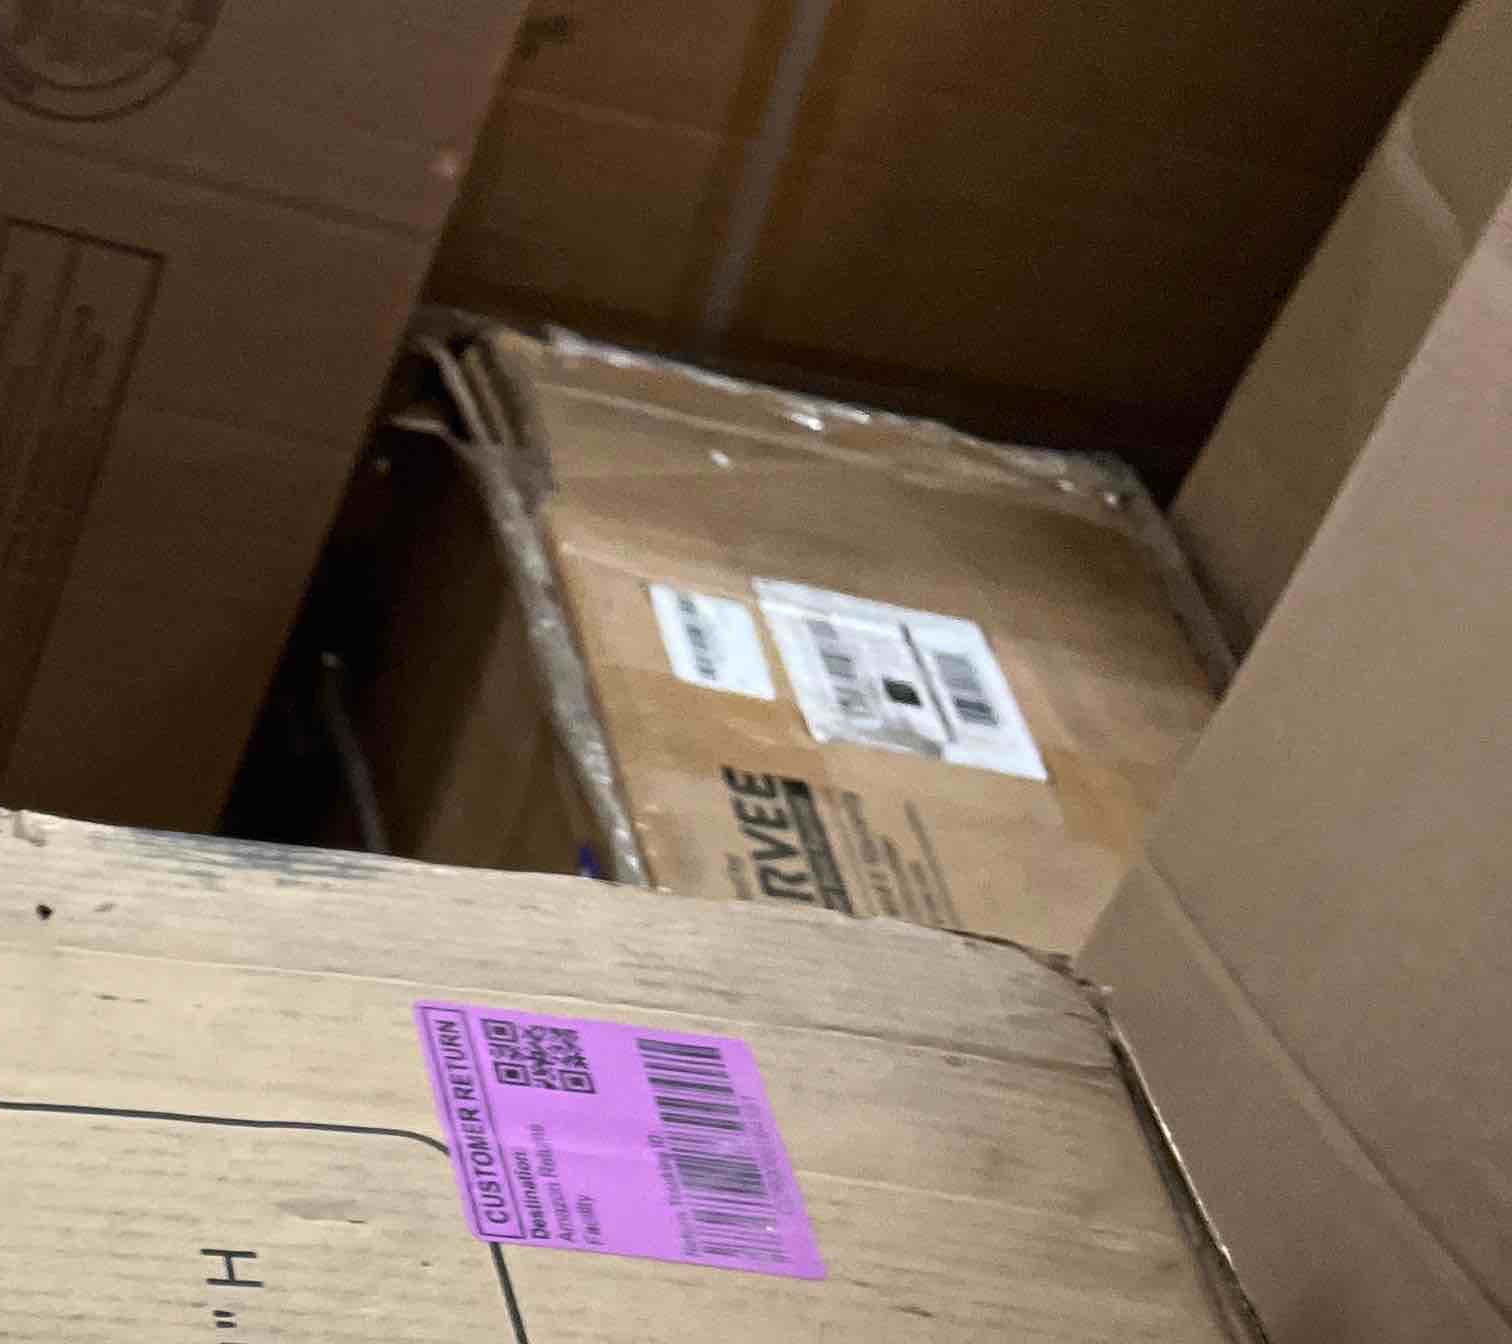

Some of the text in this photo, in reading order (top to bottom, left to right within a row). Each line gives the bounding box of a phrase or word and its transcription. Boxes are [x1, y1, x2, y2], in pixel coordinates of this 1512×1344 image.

[435, 1019, 511, 1226] CUSTOMER RETURN
[201, 1249, 262, 1287] H
